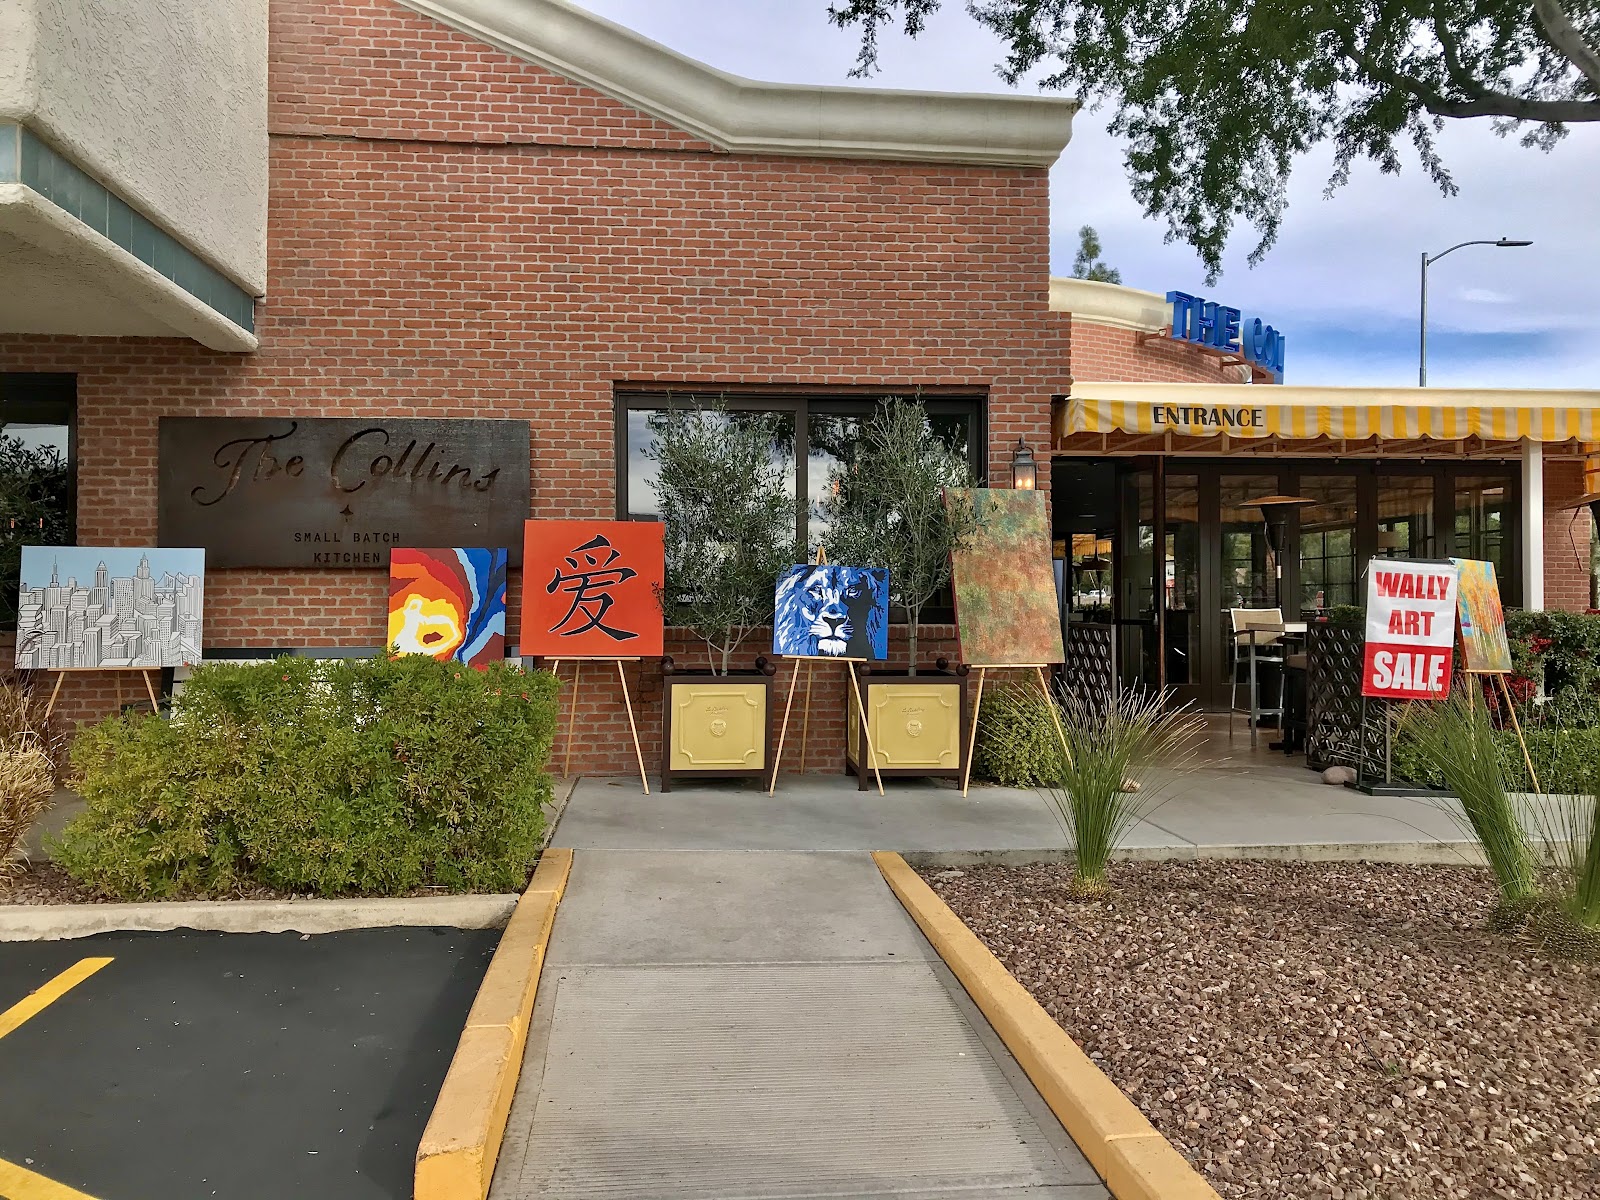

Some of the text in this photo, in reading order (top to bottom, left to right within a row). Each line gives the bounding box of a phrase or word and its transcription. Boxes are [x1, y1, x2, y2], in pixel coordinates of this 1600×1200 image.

[1166, 291, 1241, 352] THE
[1153, 406, 1264, 427] ENTRANCE
[190, 421, 501, 506] The Collins
[294, 532, 401, 543] SMALL BATCH
[313, 552, 381, 564] KITCHEN
[546, 533, 640, 642] 爱
[1375, 571, 1451, 601] WALLY
[1387, 609, 1436, 637] ART
[1372, 650, 1446, 692] SALE
